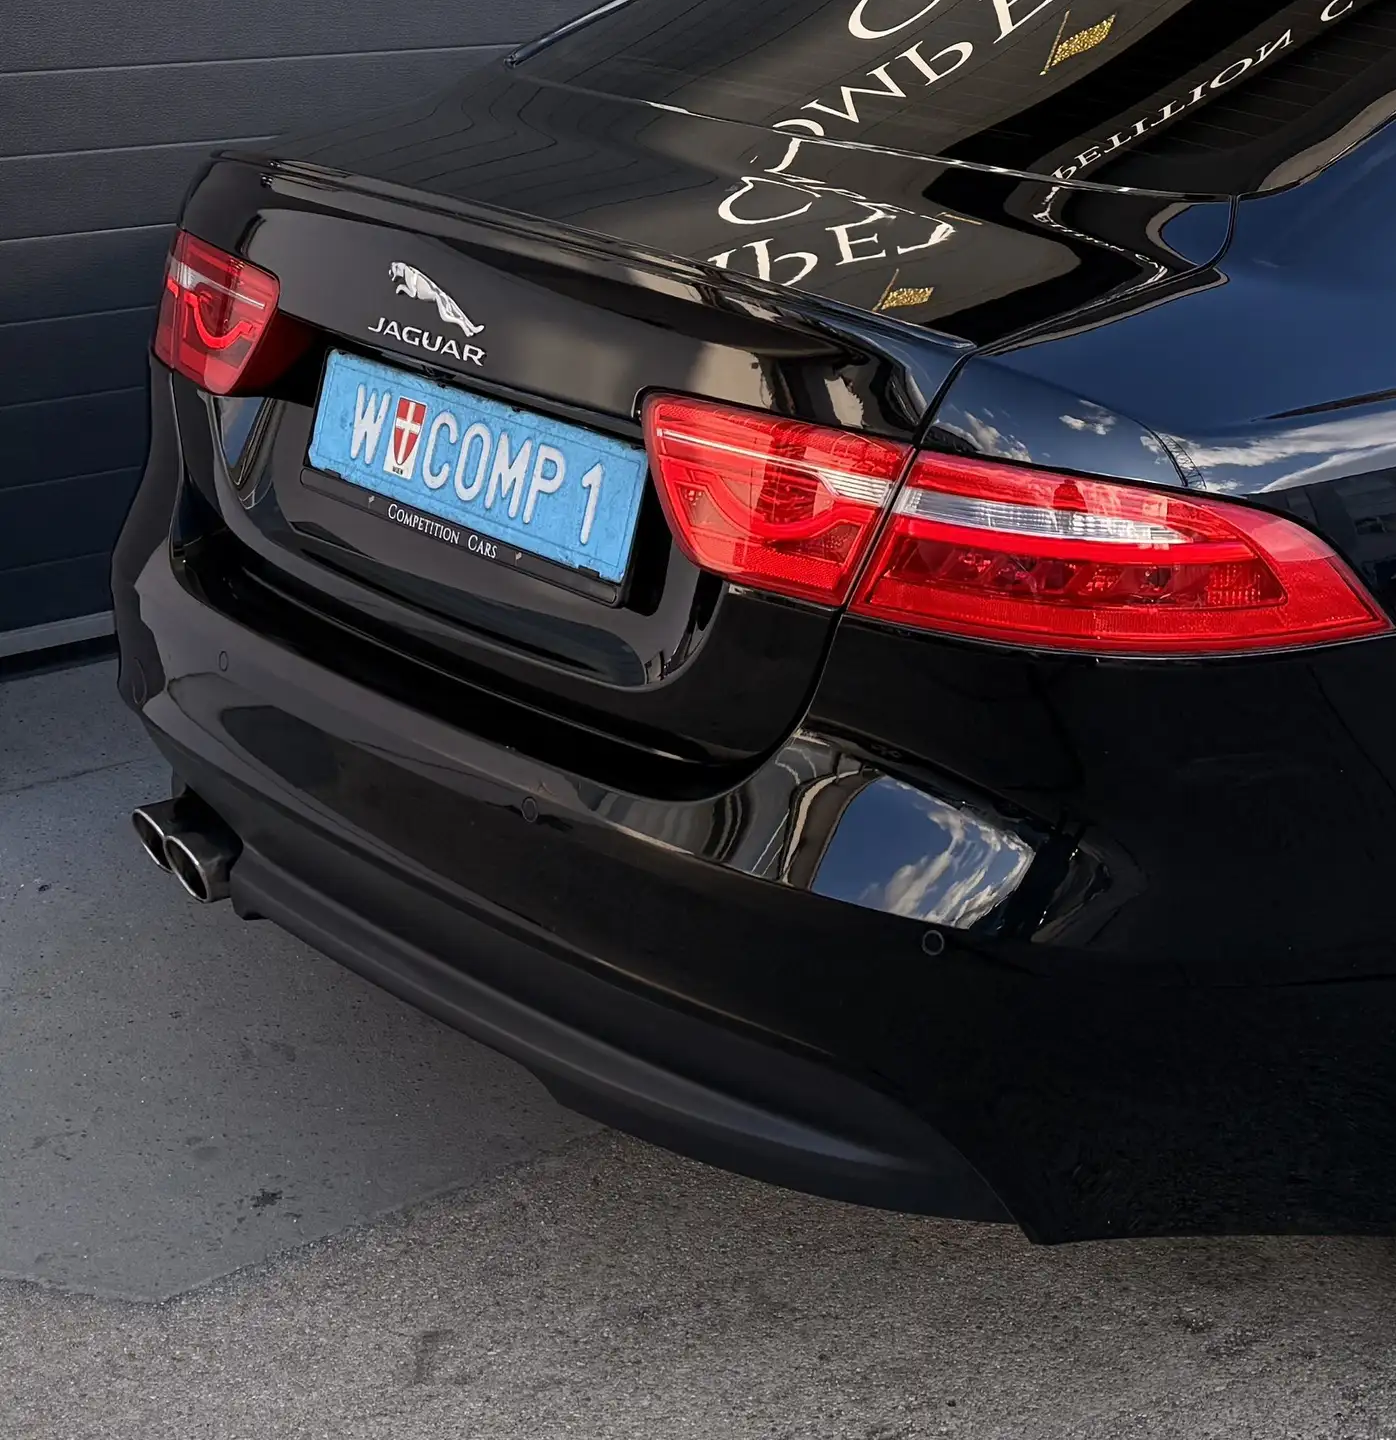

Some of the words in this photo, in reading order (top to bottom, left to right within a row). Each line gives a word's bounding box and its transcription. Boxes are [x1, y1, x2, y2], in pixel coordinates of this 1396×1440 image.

[367, 317, 486, 367] JAGUAR
[350, 382, 391, 465] W
[421, 410, 566, 524] COMP
[580, 462, 605, 546] 1
[388, 503, 460, 544] COMPETITION
[467, 534, 498, 559] CARS
